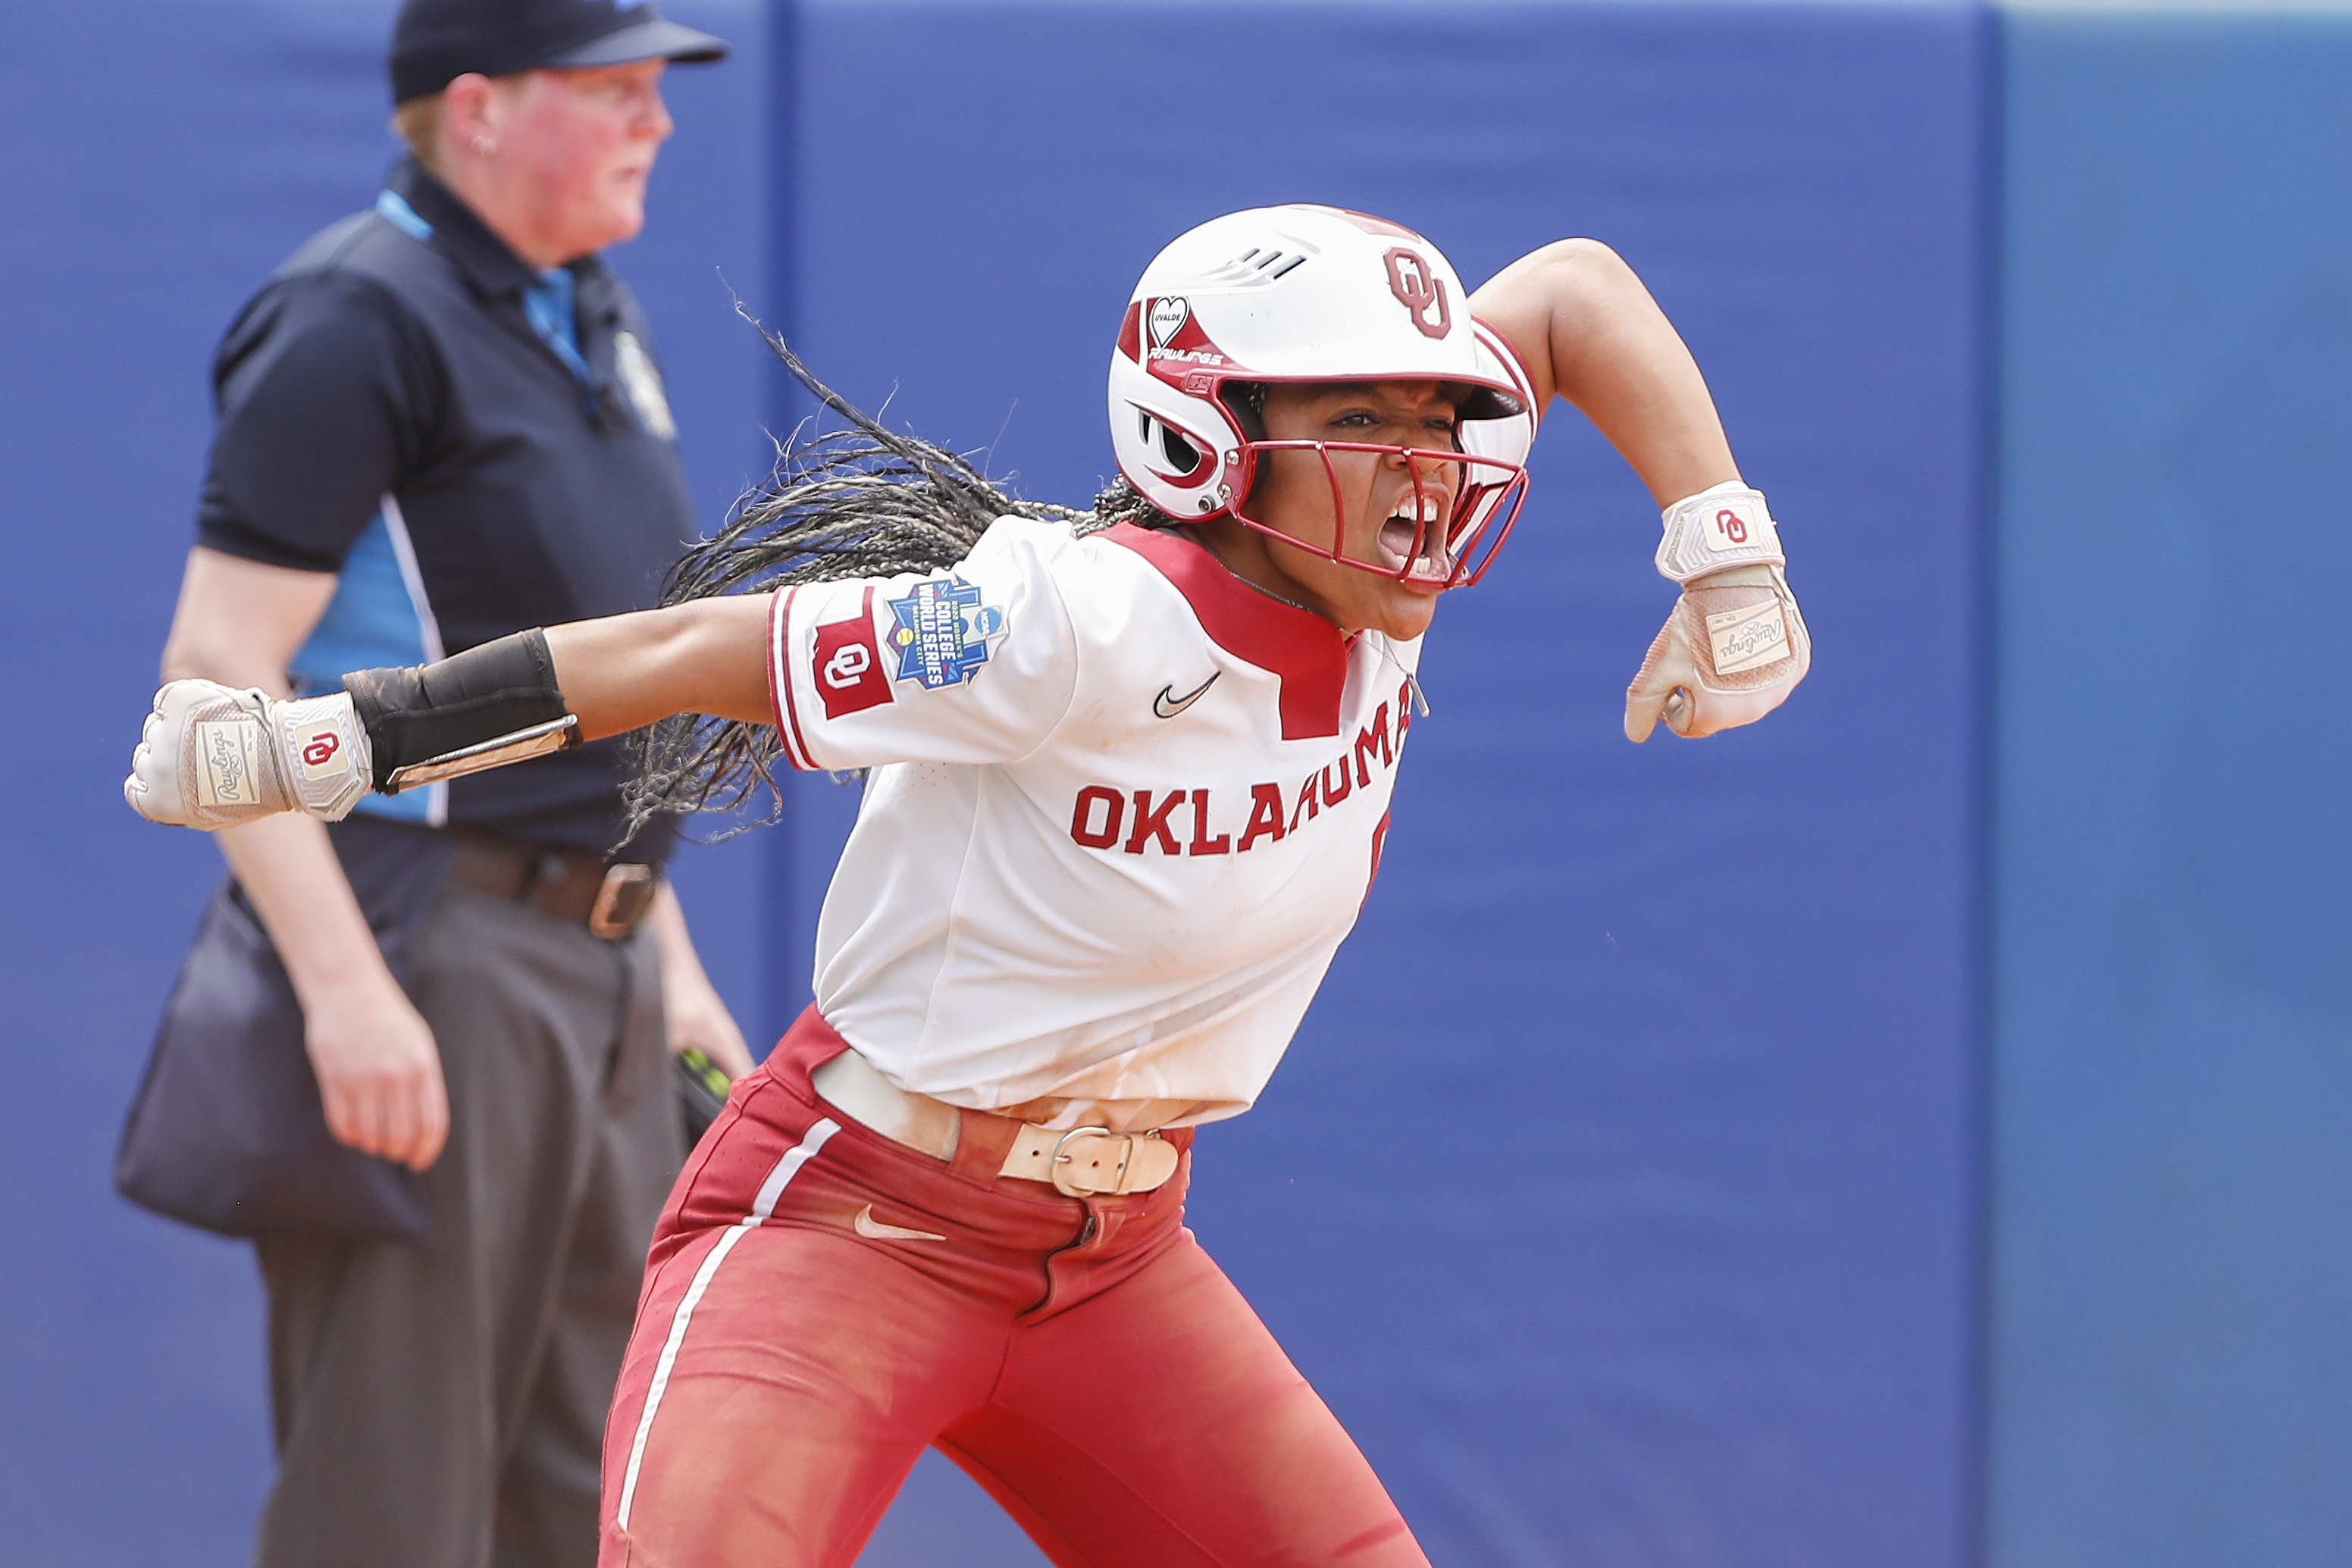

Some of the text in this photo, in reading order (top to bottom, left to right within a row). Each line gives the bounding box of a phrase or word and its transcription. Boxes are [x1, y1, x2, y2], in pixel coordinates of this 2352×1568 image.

[1383, 246, 1452, 340] OU
[1154, 313, 1181, 322] UVALDE
[1148, 347, 1224, 366] RAWLINGS
[1715, 509, 1748, 543] OU
[913, 605, 924, 665] OKLAHOMA CITY
[919, 583, 944, 684] WORLD SERIES
[935, 601, 957, 661] COLLEGE
[980, 611, 990, 635] NCAA
[1720, 618, 1781, 658] Rawlings
[823, 643, 871, 690] OU
[211, 728, 240, 800] Rawlings
[304, 731, 340, 765] OU
